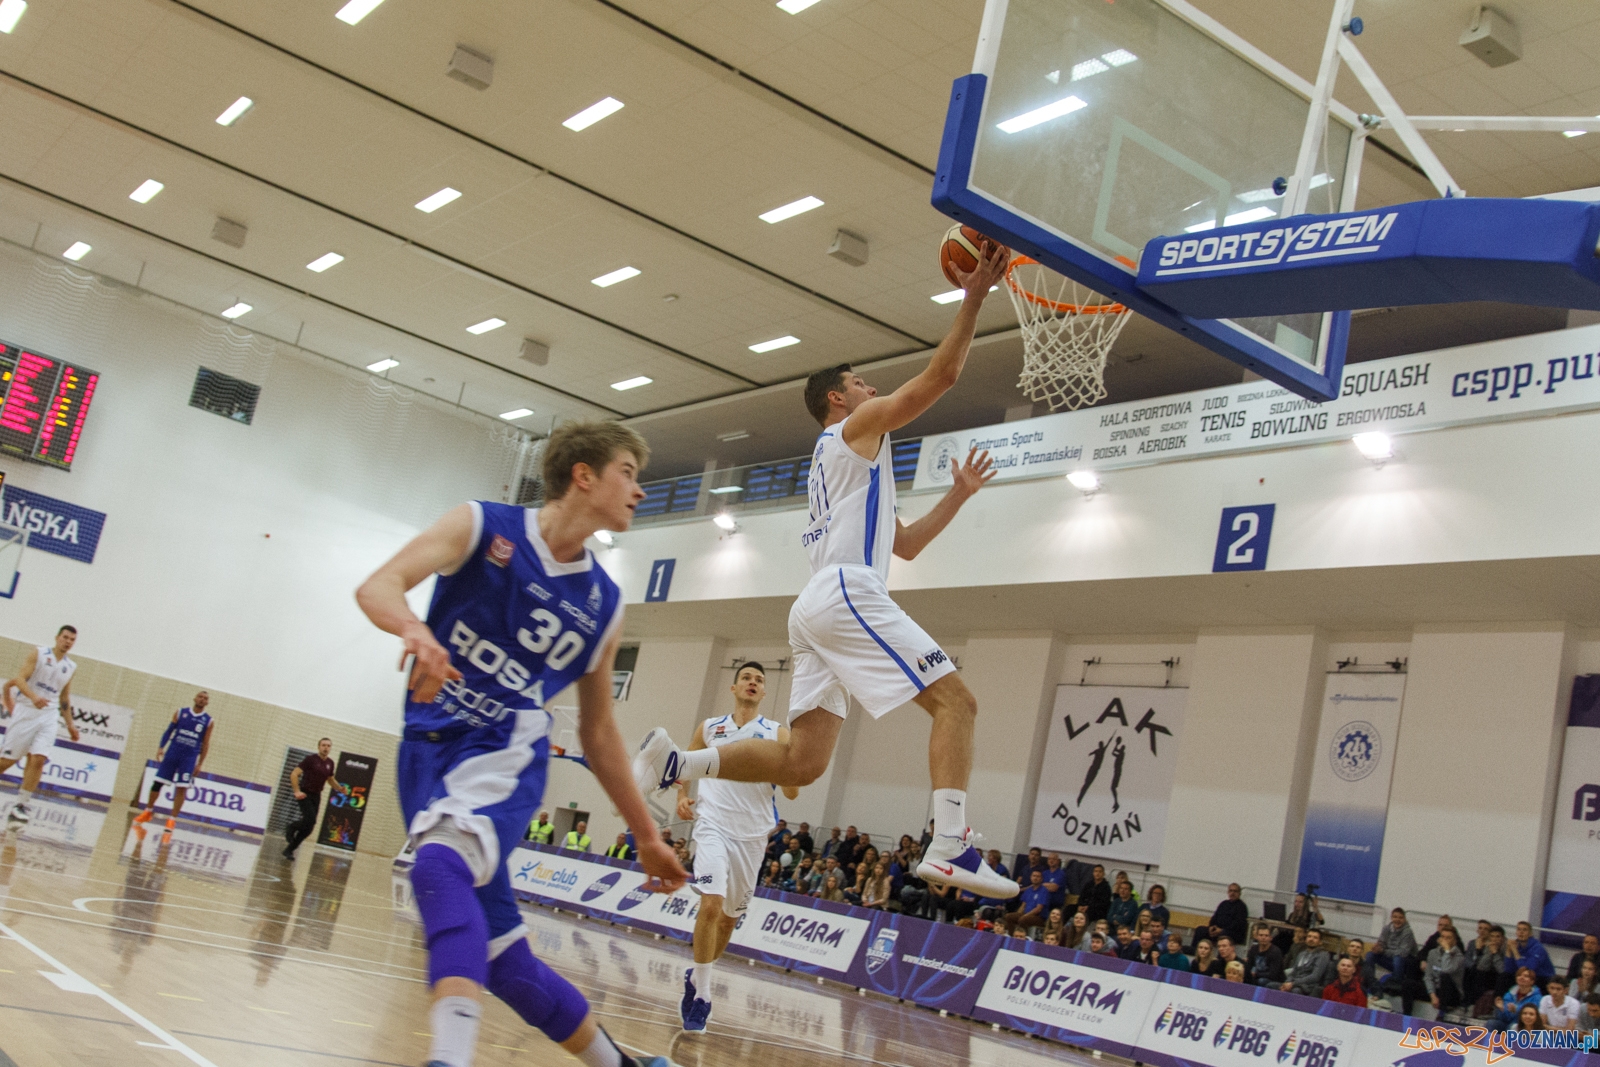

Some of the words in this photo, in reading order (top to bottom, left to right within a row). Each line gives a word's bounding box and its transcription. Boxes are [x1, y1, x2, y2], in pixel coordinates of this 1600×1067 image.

[1159, 213, 1398, 266] SPORTSYSTEM
[1342, 363, 1431, 397] SQUASH
[1452, 351, 1600, 401] cspp.pu
[1100, 411, 1129, 427] HALA
[1132, 401, 1192, 422] SPORTOWA
[1202, 396, 1229, 411] JUDO
[1336, 401, 1426, 427] ERGOWIOSŁA
[1160, 420, 1189, 432] SZACHY
[1201, 410, 1246, 432] TENIS
[1250, 412, 1328, 439] BOWLING
[968, 437, 1009, 451] Centrum
[1011, 431, 1044, 448] Sportu
[1093, 445, 1127, 461] BOISKA
[1137, 435, 1187, 454] AEROBIK
[1204, 433, 1231, 444] KARATE
[1021, 445, 1083, 465] Poznańskiej
[1226, 512, 1260, 564] 2
[651, 563, 666, 598] 1
[517, 607, 587, 671] 30
[449, 619, 545, 708] ROSA
[1064, 697, 1174, 757] LAK
[1052, 802, 1142, 846] POZNAŃ
[533, 863, 578, 886] funclub
[761, 911, 846, 948] BIOFARM
[1003, 965, 1126, 1015] BIOFARM
[1006, 995, 1031, 1007] POLSKI
[1033, 1001, 1075, 1017] PRODUCENT
[1077, 1011, 1104, 1024] LEKÓW
[1177, 1002, 1213, 1017] fundacja
[1237, 1016, 1275, 1031] fundacja
[1167, 1010, 1209, 1042] PBG
[1227, 1024, 1271, 1057] PBG
[1292, 1039, 1339, 1067] PBG
